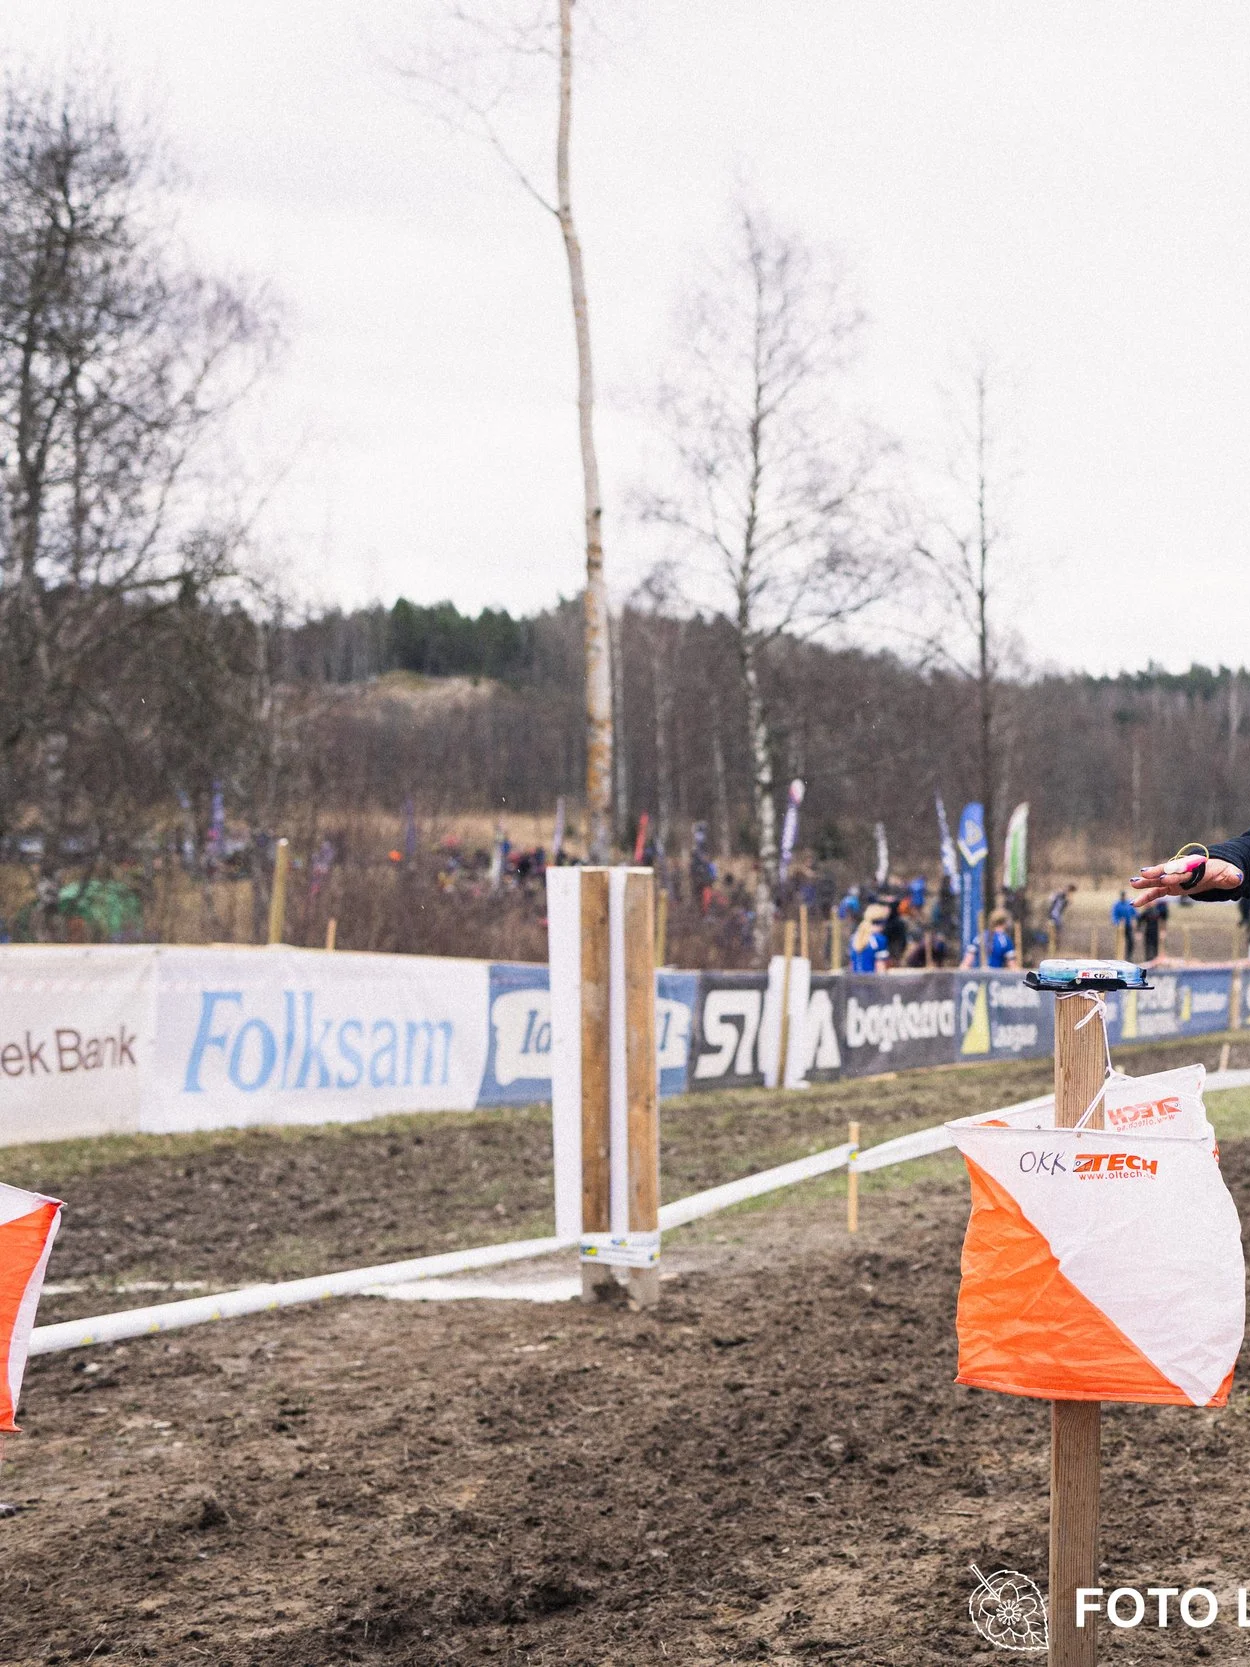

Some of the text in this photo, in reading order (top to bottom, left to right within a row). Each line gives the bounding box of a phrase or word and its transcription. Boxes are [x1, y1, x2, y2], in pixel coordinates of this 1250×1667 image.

[0, 1025, 137, 1077] ek Bank
[183, 991, 455, 1093] Folksam
[1019, 1151, 1066, 1175] OKK
